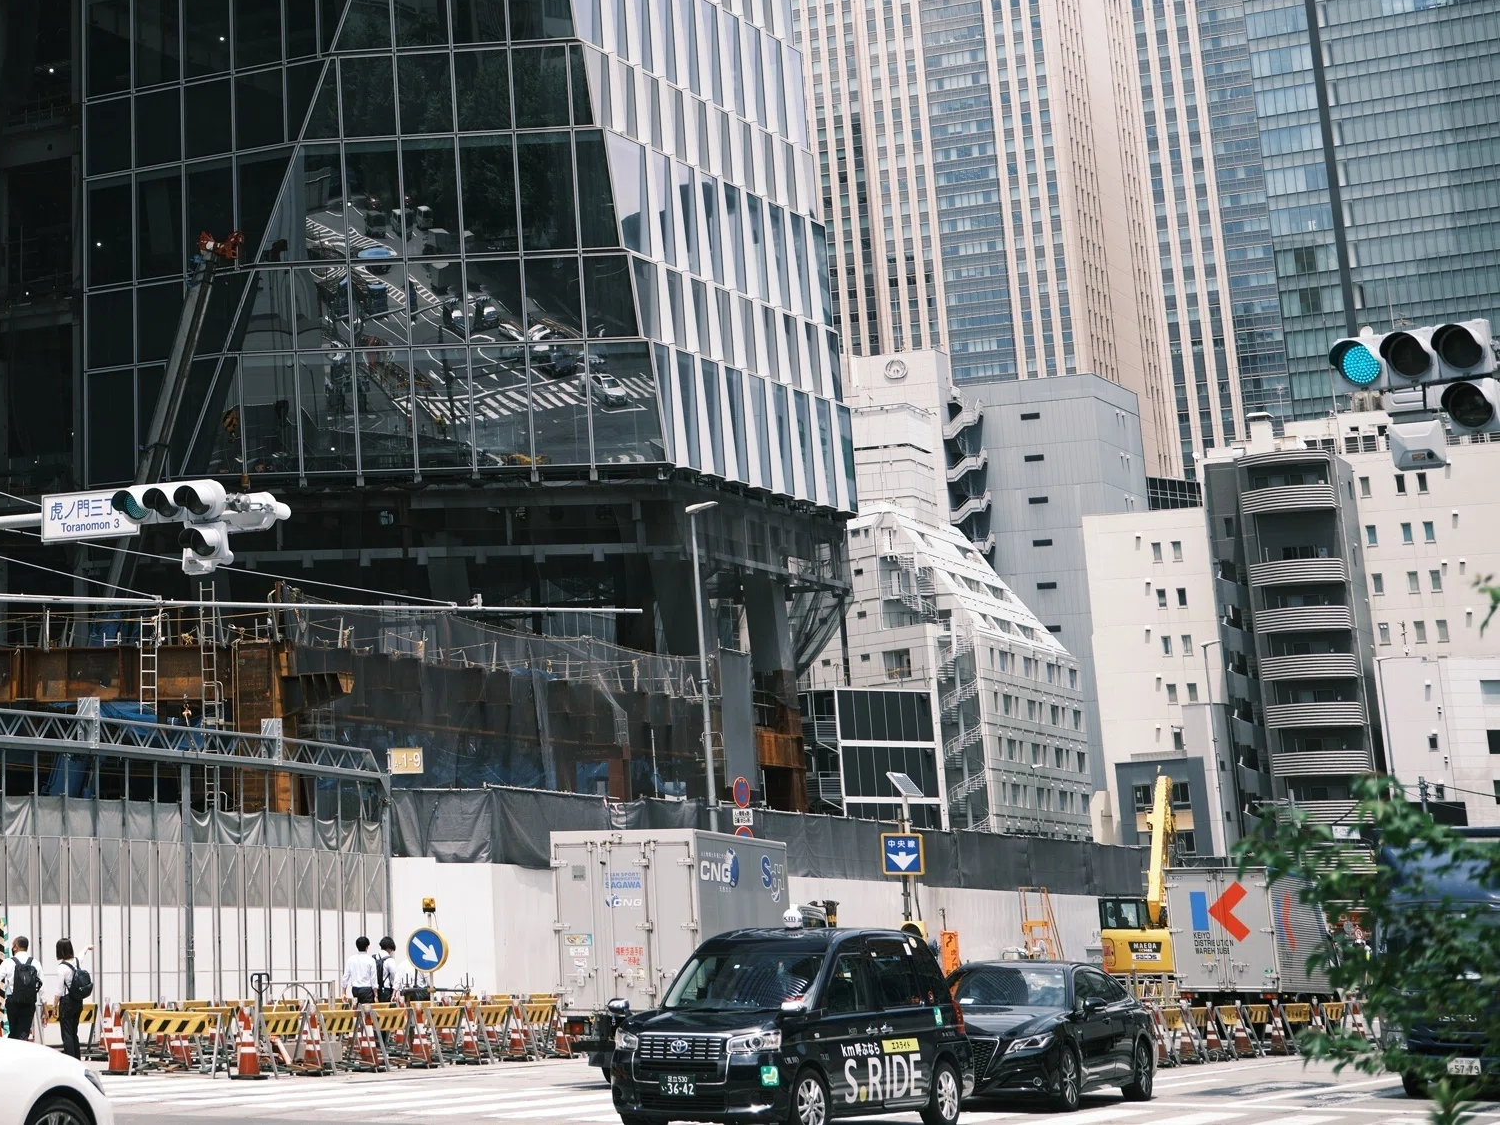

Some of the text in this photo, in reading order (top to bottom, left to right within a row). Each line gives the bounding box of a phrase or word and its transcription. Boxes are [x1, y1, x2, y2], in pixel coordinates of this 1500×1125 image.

[50, 498, 124, 521] 虎ノ門三丁
[61, 518, 121, 533] Toranomon 3
[887, 839, 916, 848] 中央線
[700, 860, 732, 884] CNG
[605, 881, 642, 889] SAGAWA
[613, 898, 643, 907] CNG
[1193, 931, 1211, 939] KEIYO
[844, 1053, 923, 1104] S.RIDE
[667, 1082, 695, 1095] 36-42
